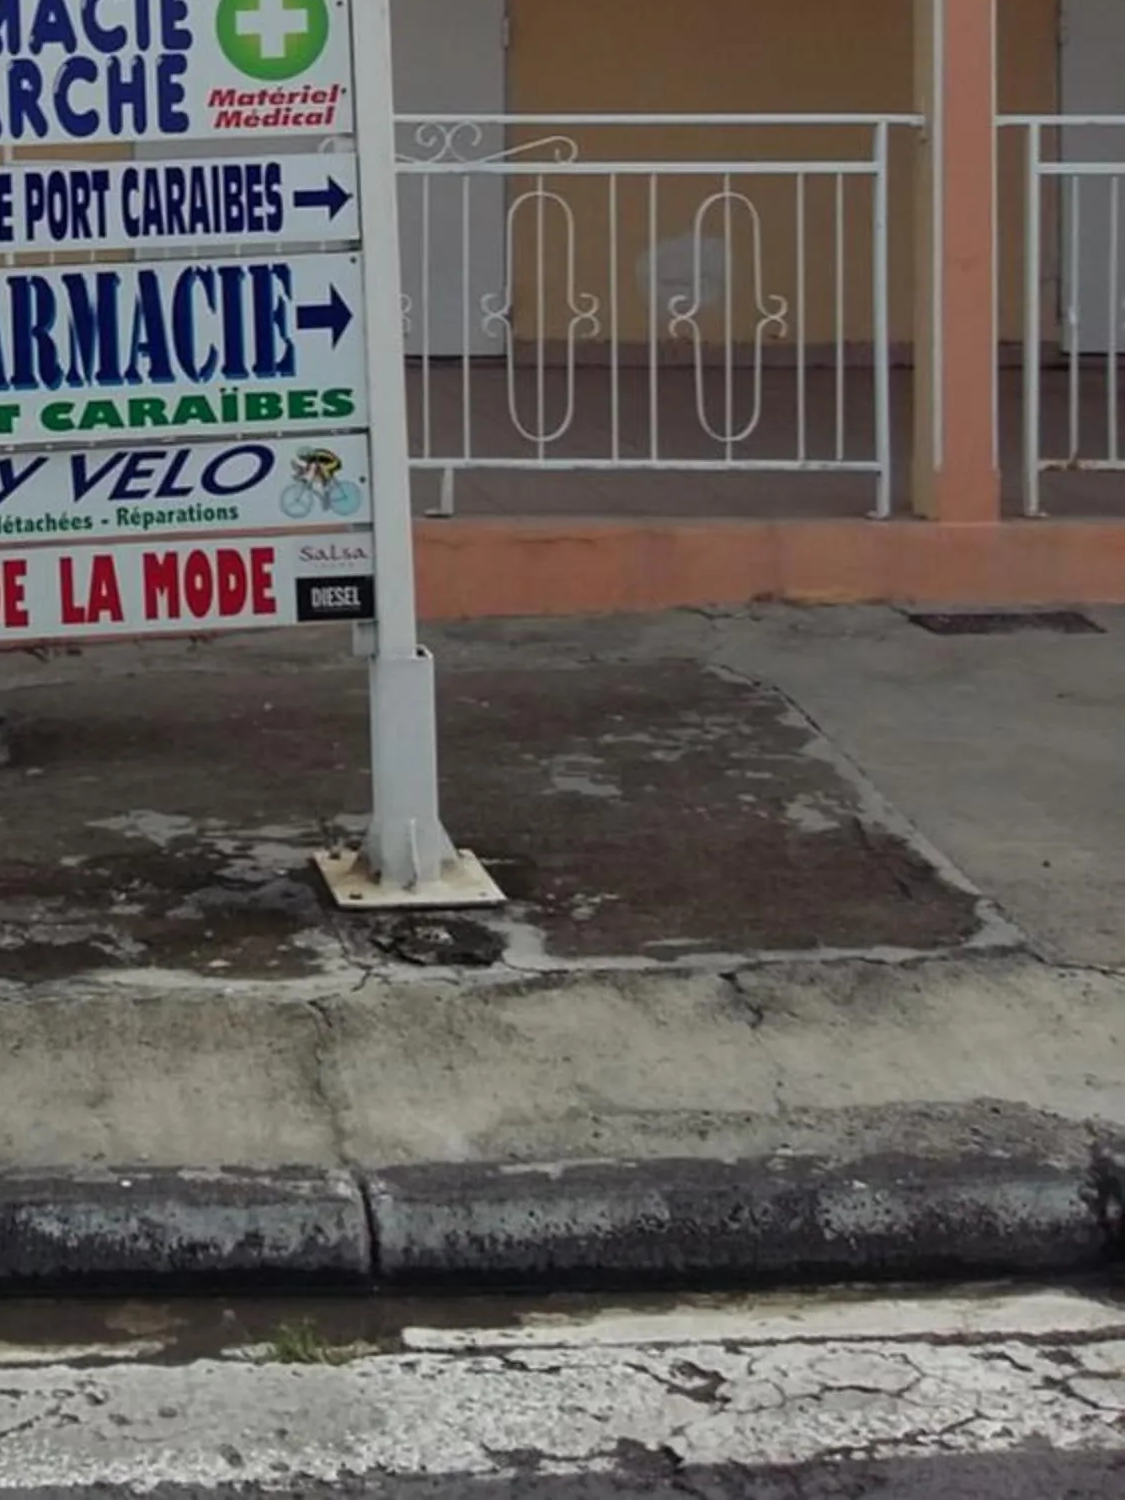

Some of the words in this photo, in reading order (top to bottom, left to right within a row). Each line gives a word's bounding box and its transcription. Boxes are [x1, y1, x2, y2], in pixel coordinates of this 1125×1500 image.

[25, 168, 111, 241] PORT
[121, 161, 284, 237] CARAIBES
[40, 387, 357, 433] CARAÏBES
[69, 443, 276, 503] VELO
[116, 503, 239, 530] Réparations
[299, 543, 368, 562] Salsa
[59, 553, 125, 625] LA
[143, 546, 277, 620] MODE
[311, 586, 361, 607] DIESEL
